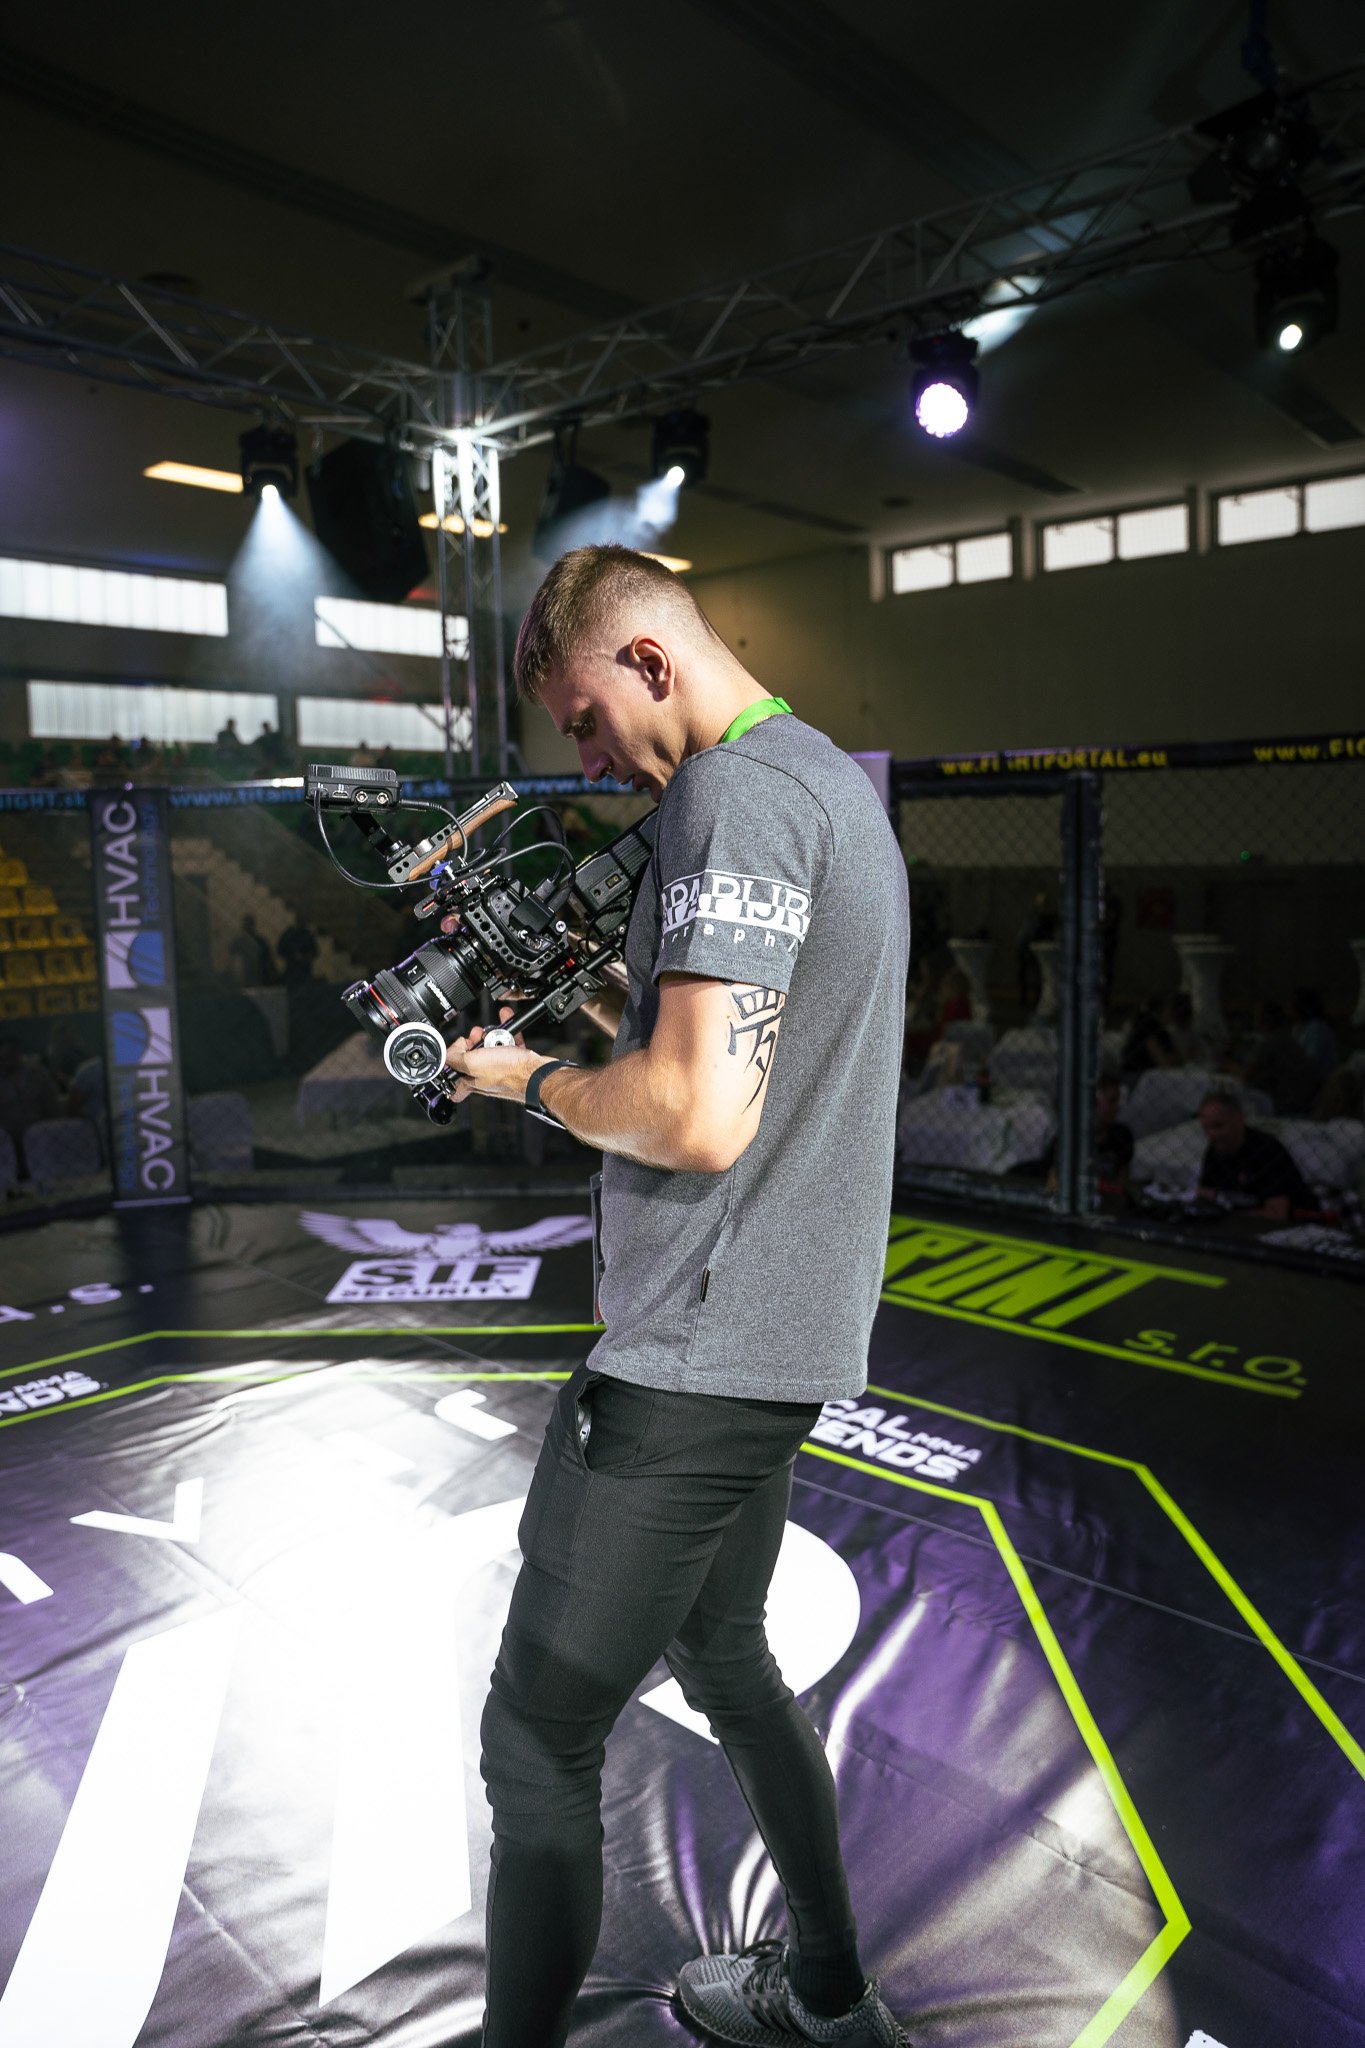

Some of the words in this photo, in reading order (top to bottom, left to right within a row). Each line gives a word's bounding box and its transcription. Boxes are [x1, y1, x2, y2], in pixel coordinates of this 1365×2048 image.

[102, 801, 141, 927] HVAC
[138, 1068, 175, 1191] HVAC
[1123, 1329, 1307, 1386] s.r.o.
[809, 1416, 971, 1483] ENDS
